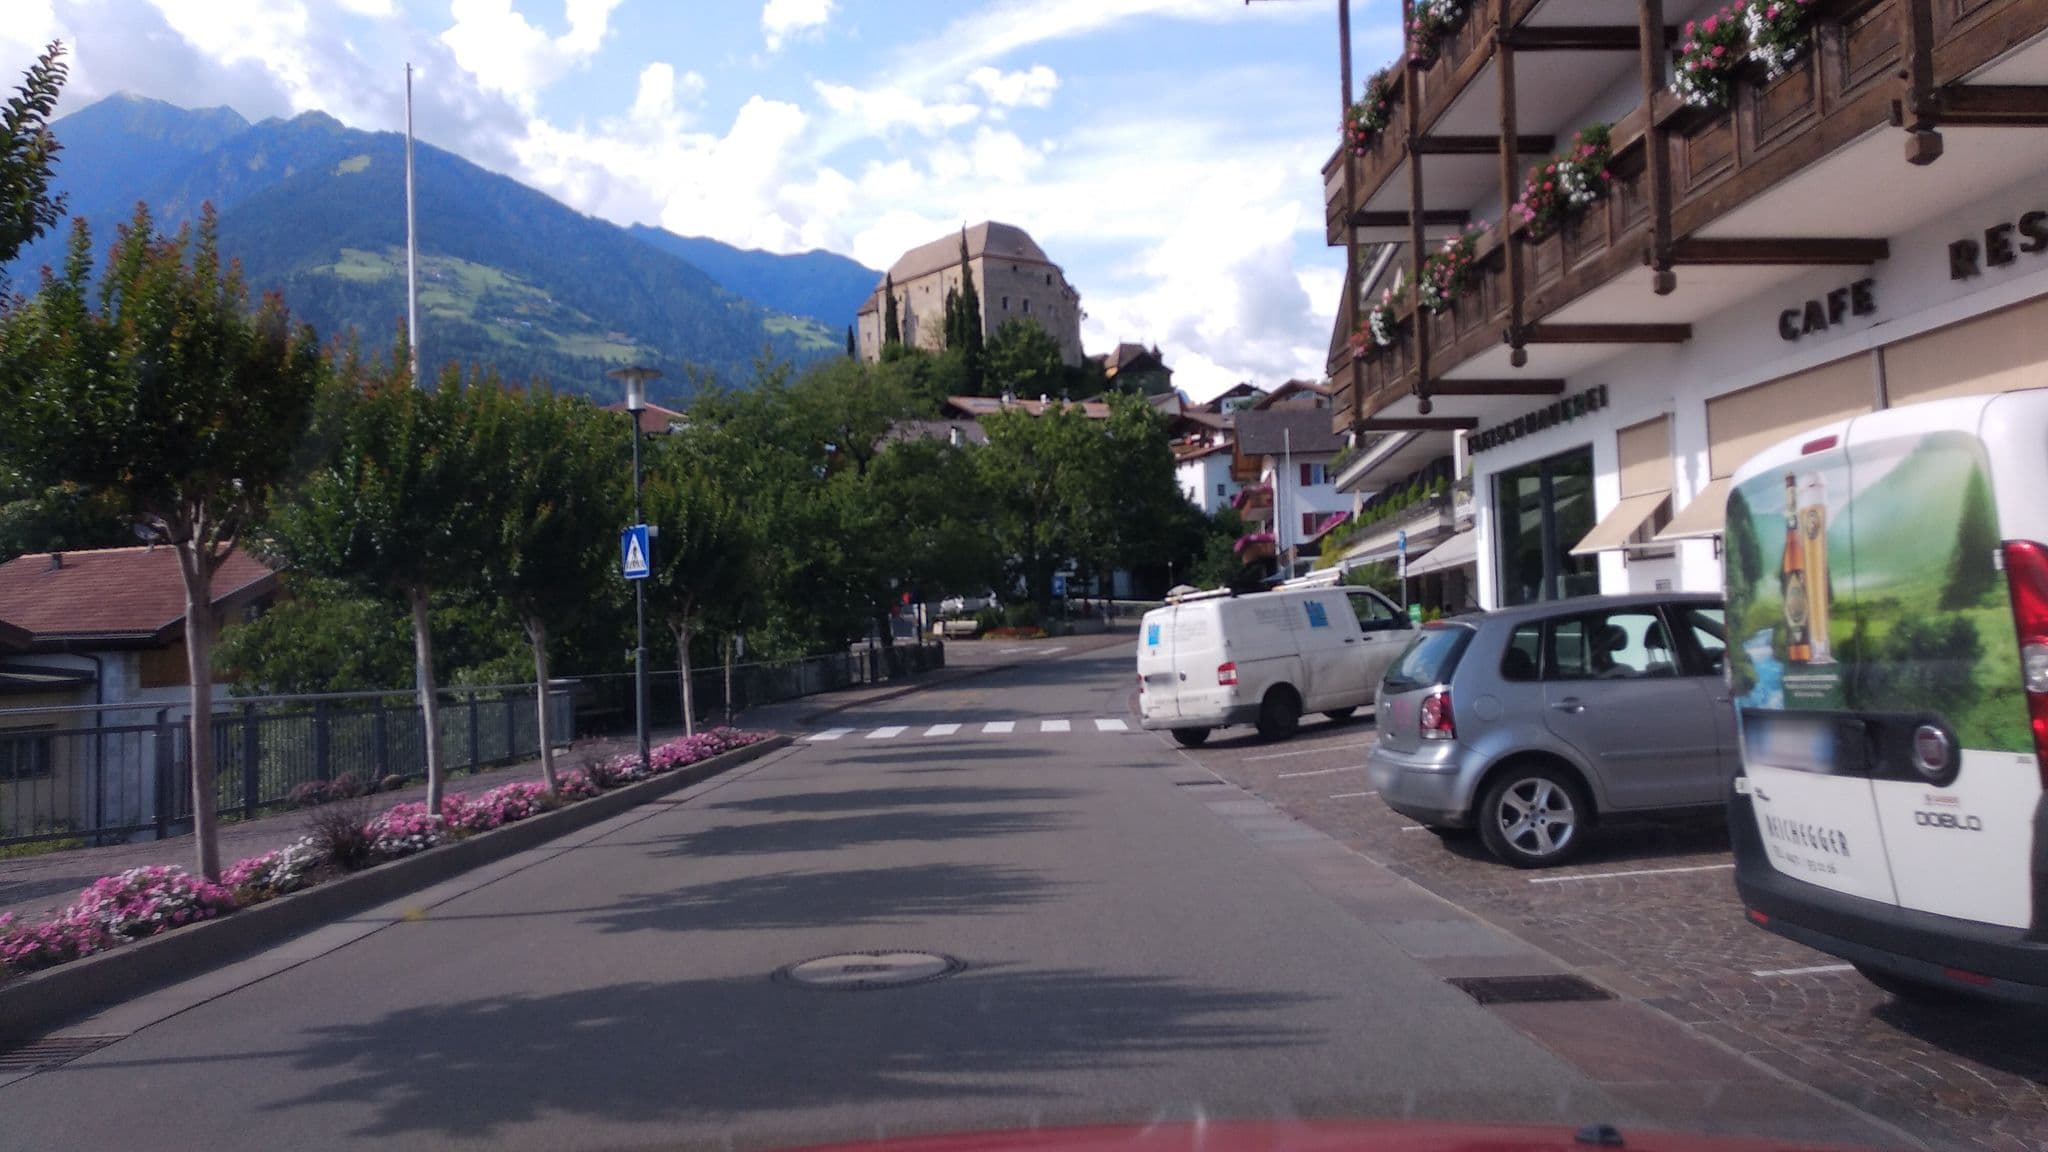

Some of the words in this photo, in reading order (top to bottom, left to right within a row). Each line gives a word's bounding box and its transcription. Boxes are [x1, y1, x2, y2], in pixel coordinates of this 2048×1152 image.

[1778, 277, 1876, 341] CAFE
[1948, 210, 2048, 280] RES
[1914, 810, 1983, 832] DOBLO
